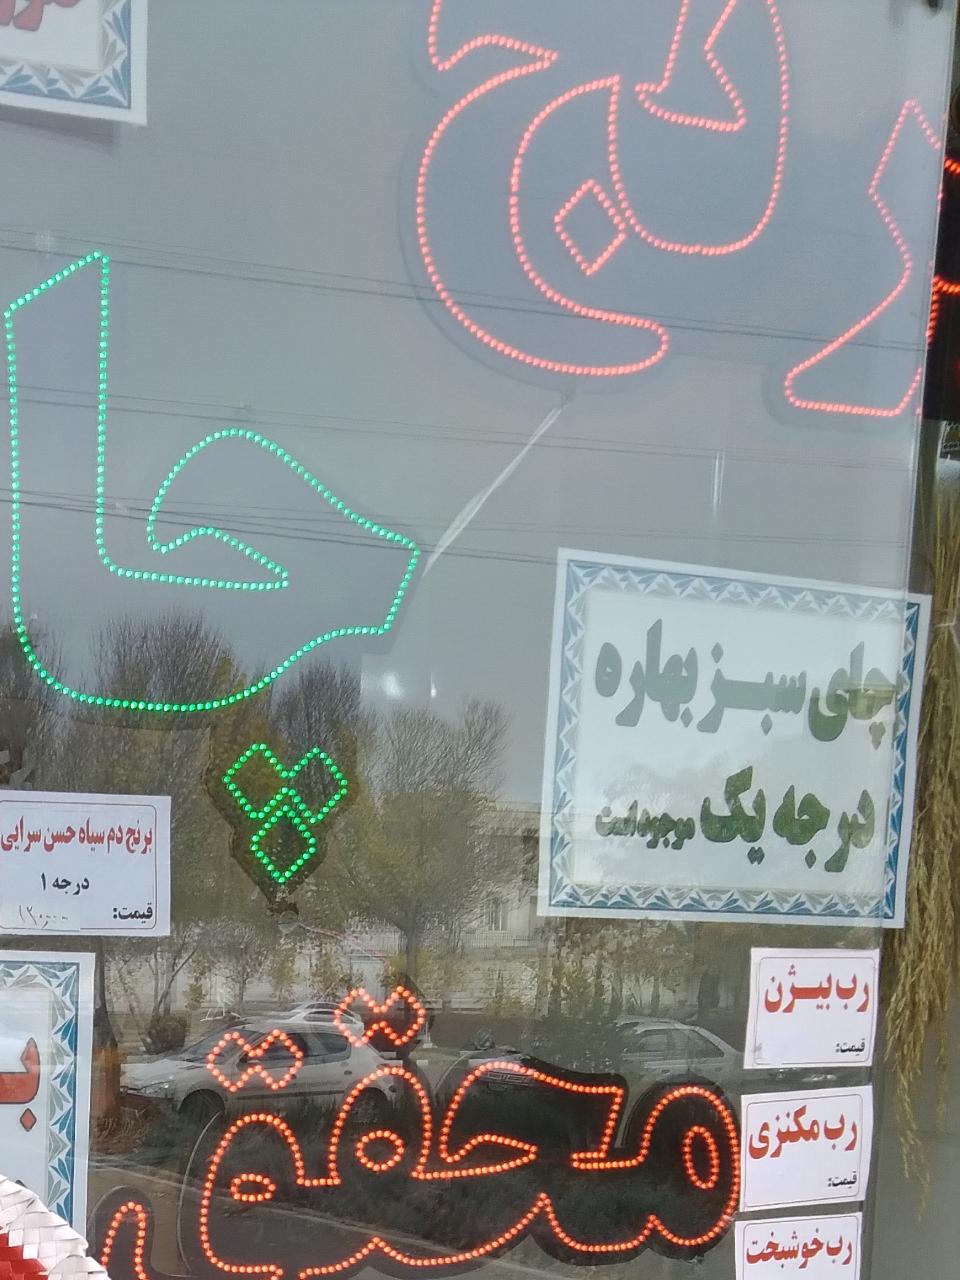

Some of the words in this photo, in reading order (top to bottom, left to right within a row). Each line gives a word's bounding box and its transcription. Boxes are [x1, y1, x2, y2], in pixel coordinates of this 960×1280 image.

[594, 618, 699, 729] بهاره
[696, 641, 808, 736] سبز
[806, 641, 898, 750] چای
[79, 818, 105, 852] سیاه
[700, 765, 768, 866] یک
[773, 785, 877, 873] درجه
[44, 824, 76, 853] حسن
[107, 825, 123, 853] دم
[125, 820, 153, 854] برنج
[52, 875, 90, 895] درجه
[764, 964, 834, 1014] بیژن
[836, 972, 871, 1013] رب
[747, 1104, 819, 1160] مکنزی
[823, 1110, 858, 1151] رب
[745, 1228, 824, 1270] خوشبخت
[827, 1231, 853, 1266] رب
